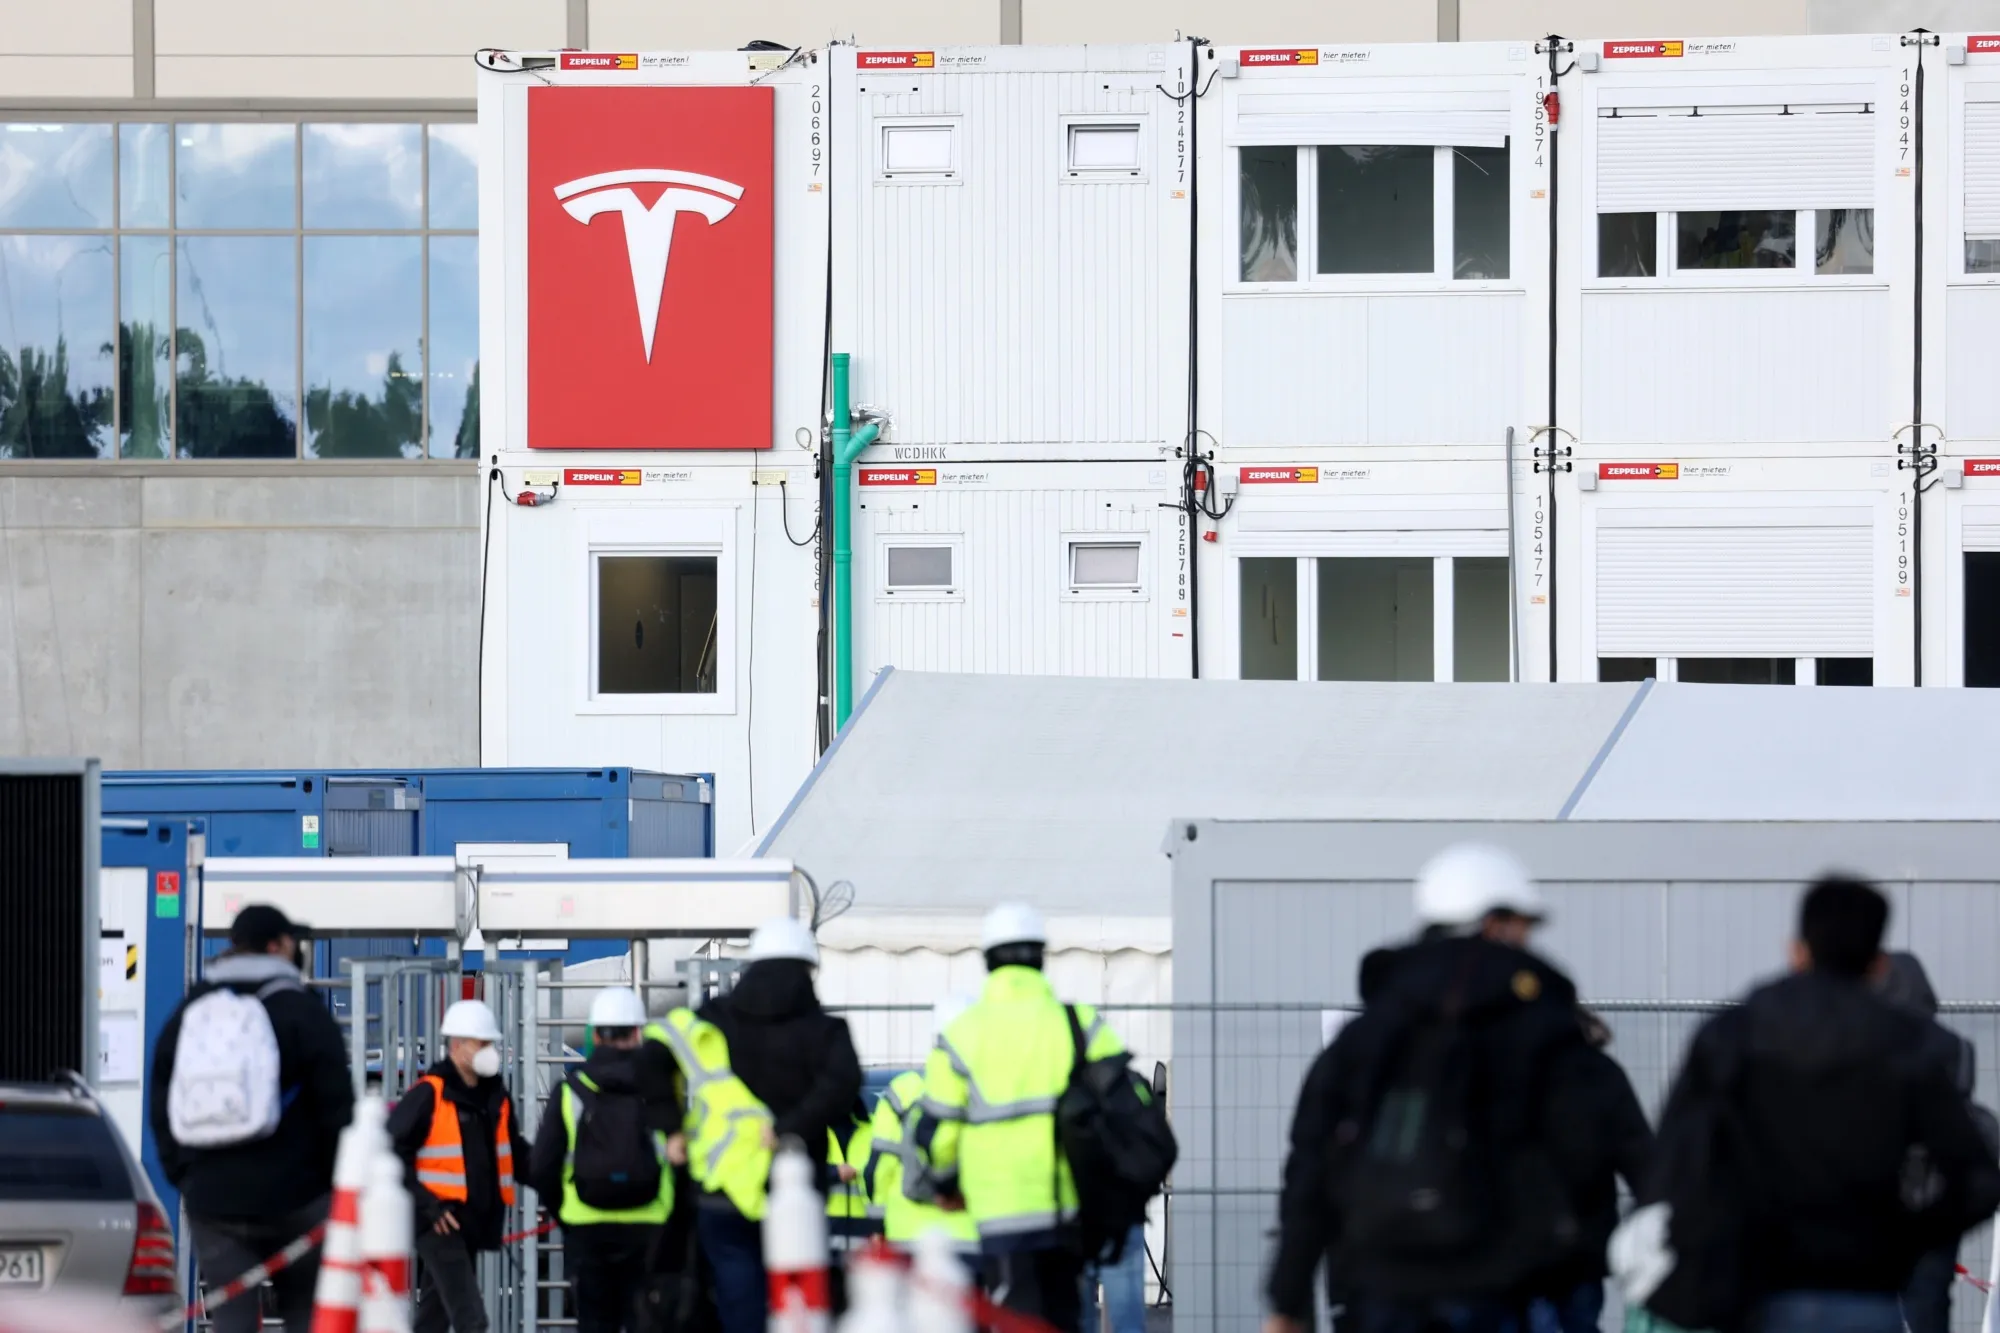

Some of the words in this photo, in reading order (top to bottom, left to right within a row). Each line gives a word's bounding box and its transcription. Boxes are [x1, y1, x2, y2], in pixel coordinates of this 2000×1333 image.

[1688, 43, 1704, 51] hier
[1976, 40, 2000, 48] ZEPP
[1612, 45, 1655, 54] ZEPPELIN
[940, 55, 955, 63] hier
[1248, 54, 1291, 62] ZEPPELIN
[1323, 51, 1339, 59] hier
[569, 58, 611, 66] ZEPPELIN
[642, 56, 658, 64] hier
[865, 56, 907, 64] ZEPPELIN
[1899, 68, 1910, 161] 194947
[1177, 66, 1185, 183] 10024577
[1534, 76, 1545, 168] 195574
[811, 84, 821, 176] 206697
[894, 447, 947, 459] WCDHKK
[1323, 469, 1339, 477] hier
[1607, 467, 1650, 475] ZEPPELIN
[1683, 465, 1699, 473] hier
[572, 473, 614, 481] ZEPPELIN
[645, 471, 661, 479] hier
[867, 473, 909, 481] ZEPPELIN
[1248, 471, 1291, 479] ZEPPELIN
[1534, 494, 1544, 587] 195477
[1897, 491, 1908, 585] 195199
[1178, 485, 1186, 601] 10025789
